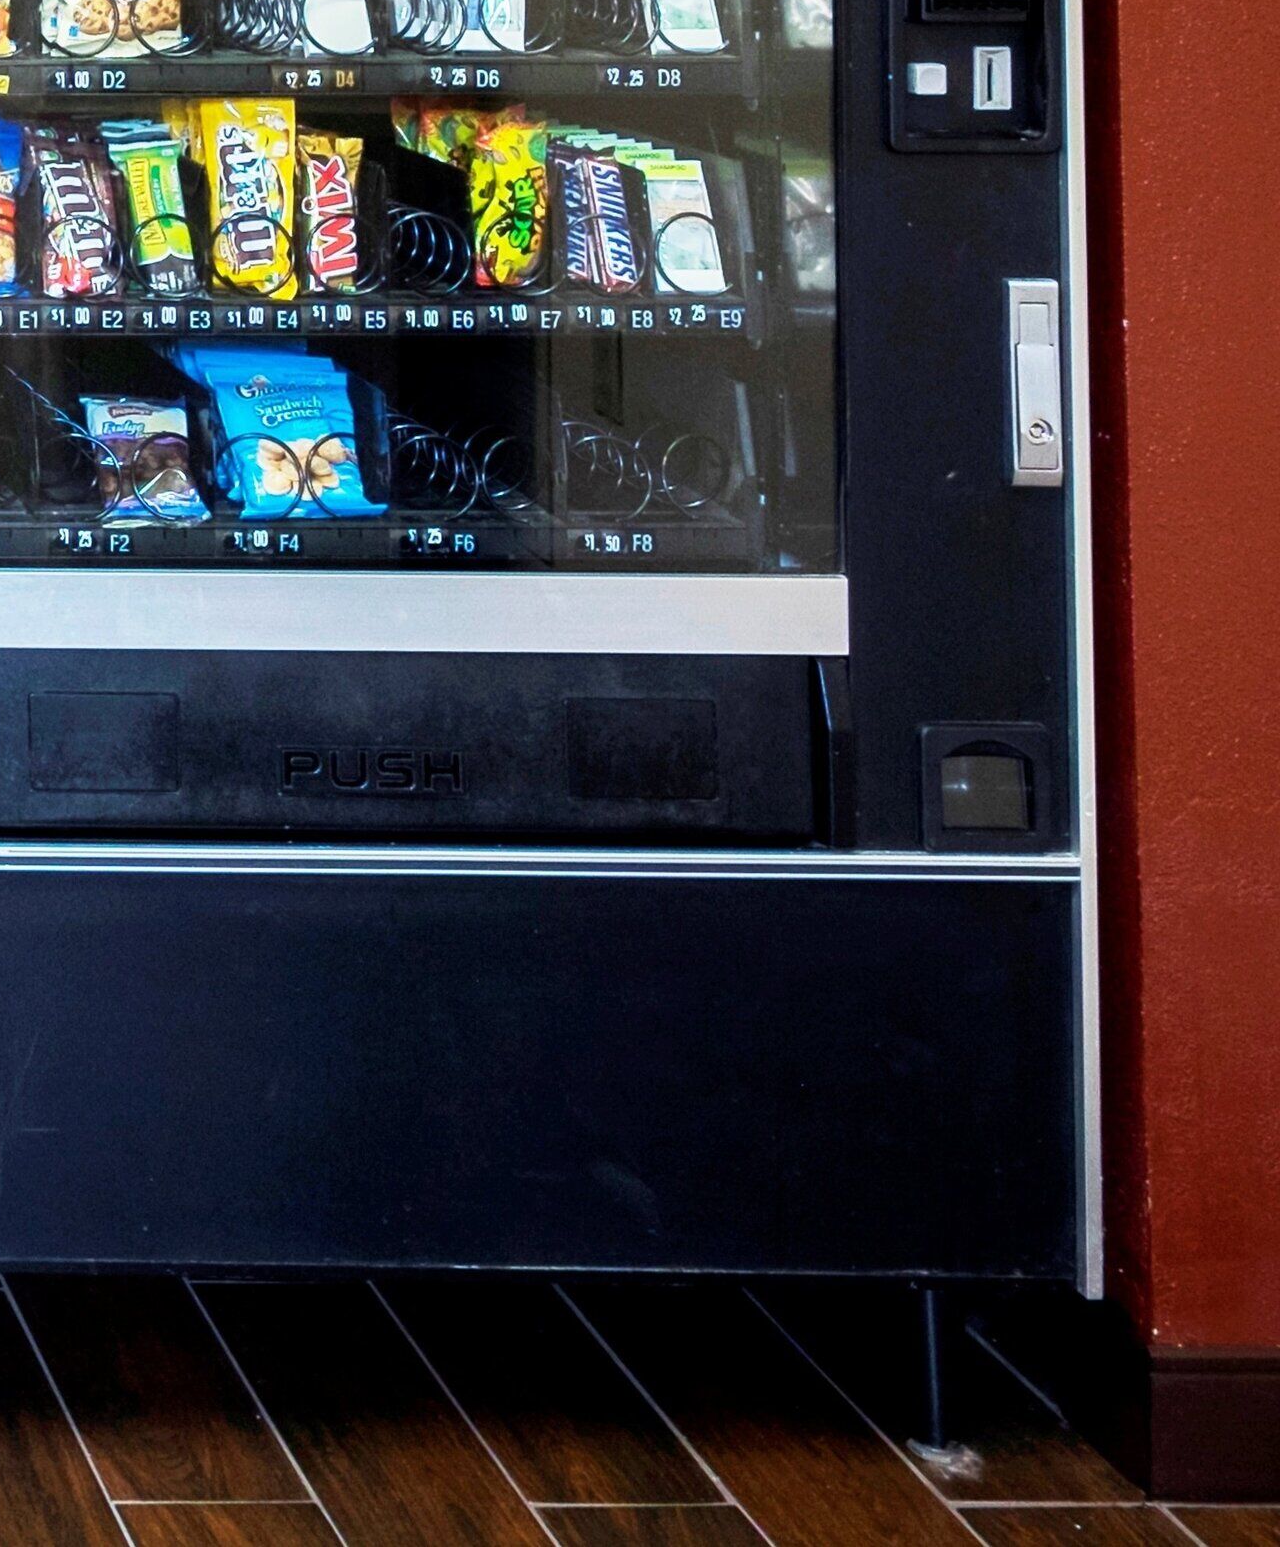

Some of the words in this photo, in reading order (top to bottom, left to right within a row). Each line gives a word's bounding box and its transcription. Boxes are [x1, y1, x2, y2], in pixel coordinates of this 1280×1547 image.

[103, 71, 126, 90] D2
[336, 70, 355, 88] D4
[476, 69, 500, 88] D6
[658, 69, 681, 87] D8
[312, 155, 359, 290] TWIX
[19, 310, 39, 329] E1
[102, 310, 124, 329] E2
[190, 310, 211, 329] E3
[277, 311, 298, 329] E4
[365, 311, 387, 329] E5
[452, 310, 474, 329] E6
[541, 311, 562, 329] E7
[632, 310, 653, 329] E8
[721, 309, 742, 328] E9
[254, 395, 323, 417] Sandwich
[261, 409, 320, 428] Cremes
[102, 419, 146, 438] Fudge
[110, 533, 130, 552] F2
[280, 534, 300, 552] F4
[454, 534, 475, 552] F6
[633, 533, 654, 552] F8
[282, 750, 466, 792] PUSH
